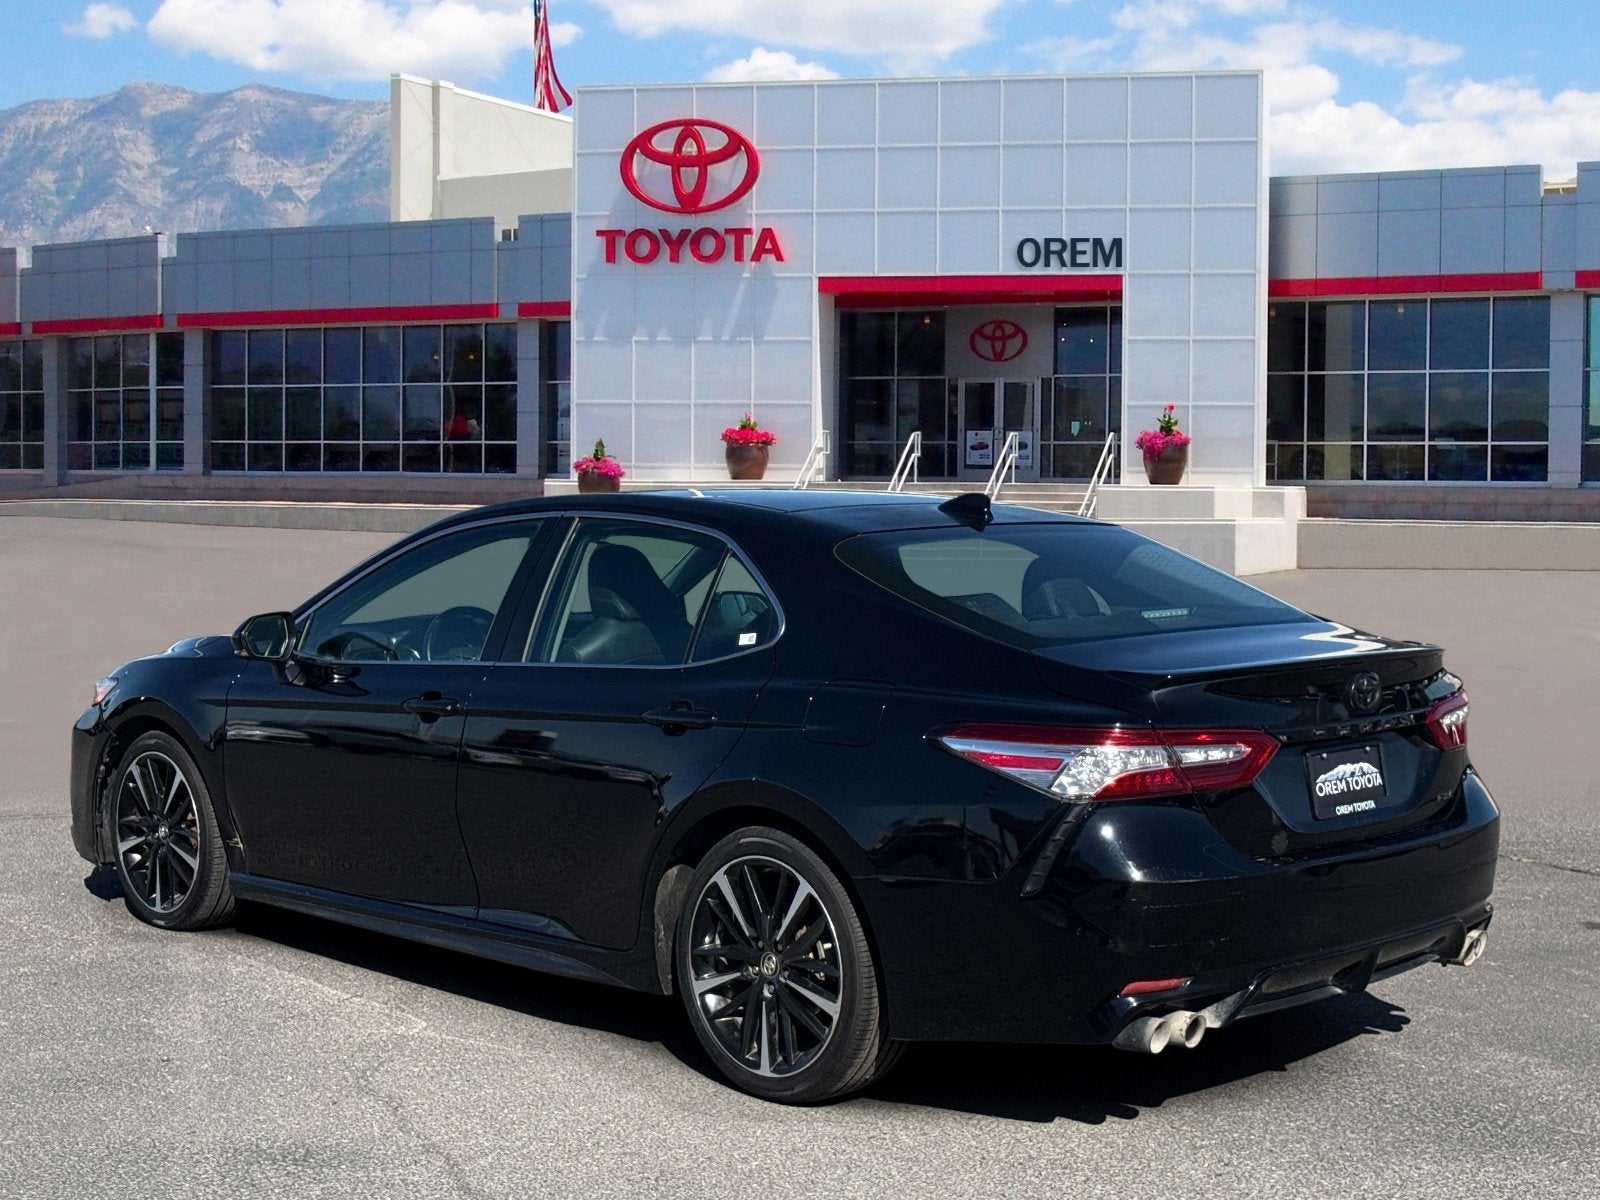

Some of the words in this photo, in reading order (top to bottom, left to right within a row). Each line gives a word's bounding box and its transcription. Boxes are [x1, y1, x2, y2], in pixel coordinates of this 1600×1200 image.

[596, 227, 784, 264] TOYOTA
[1017, 237, 1123, 268] OREM
[1316, 779, 1347, 797] OREM
[1347, 773, 1383, 791] TOYOTA
[1335, 804, 1354, 816] OREM
[1353, 800, 1376, 812] TOYOTA
